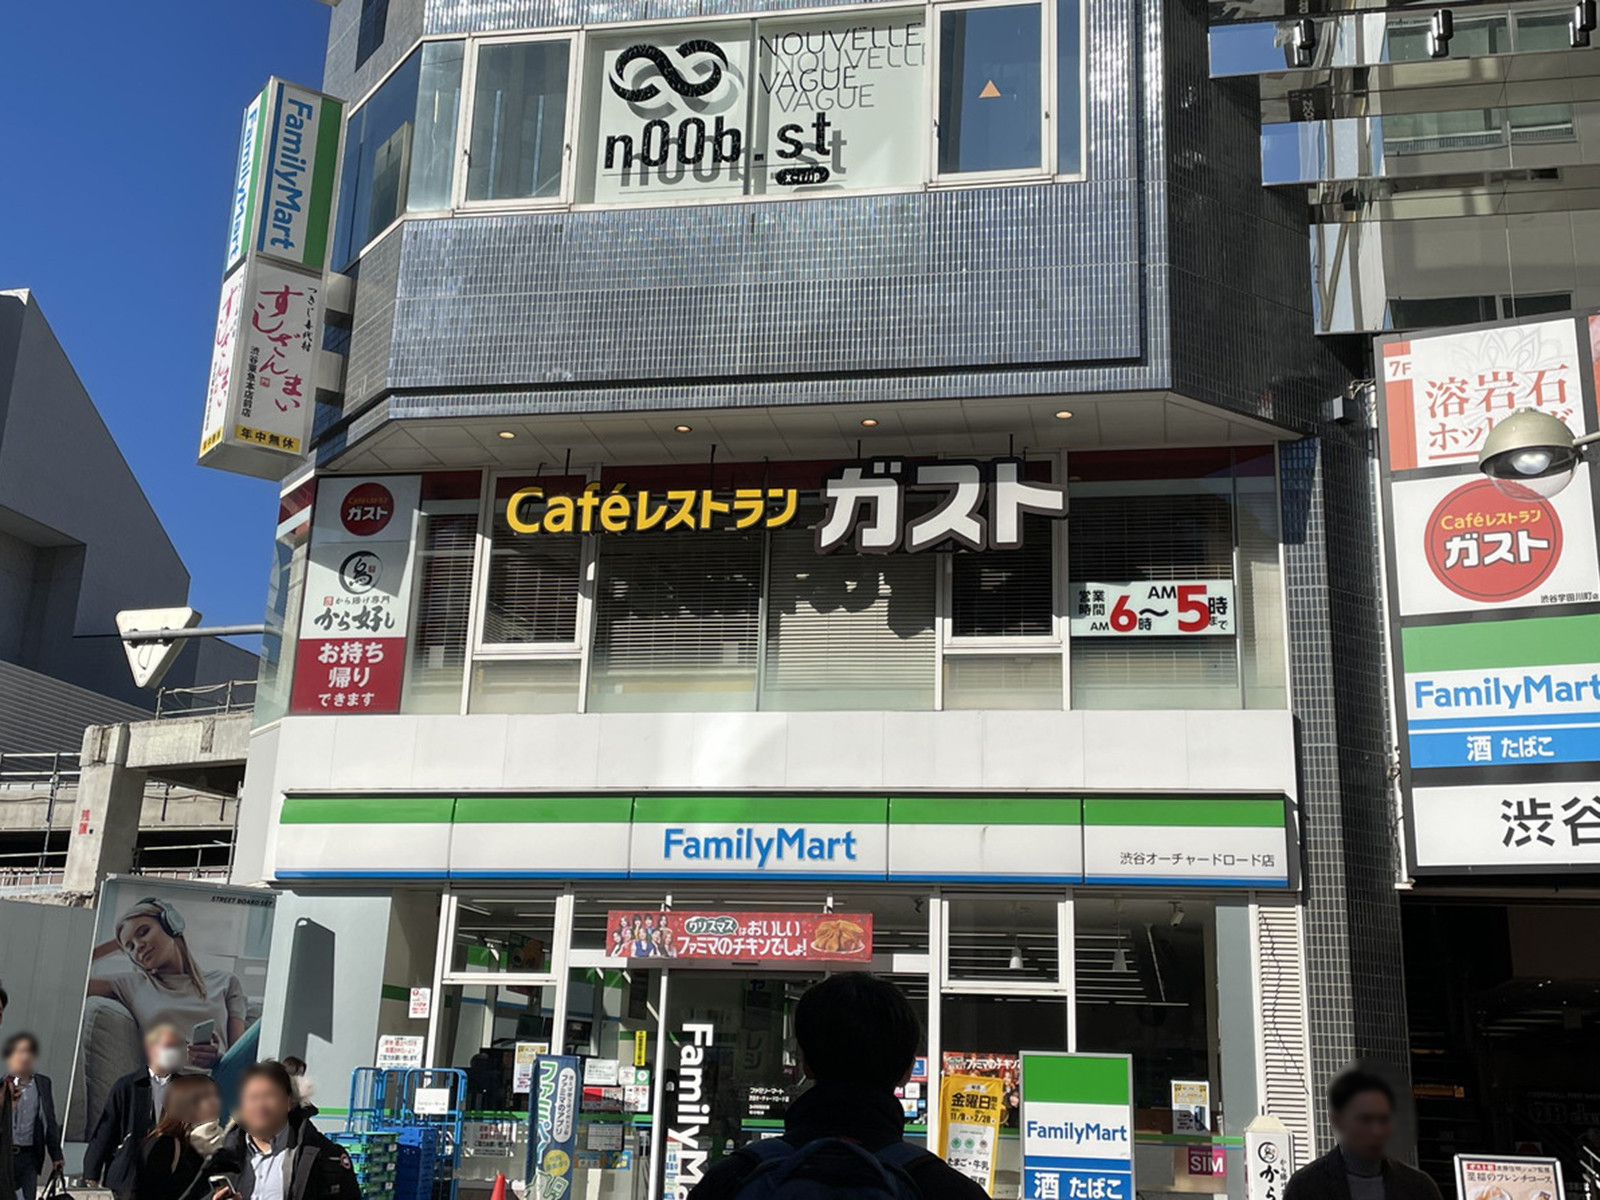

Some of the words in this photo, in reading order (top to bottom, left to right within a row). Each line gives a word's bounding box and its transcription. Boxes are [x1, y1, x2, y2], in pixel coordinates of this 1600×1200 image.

[759, 22, 922, 57] NOUVELLE
[759, 65, 859, 95] VAGUE
[269, 98, 312, 250] FamilyMart
[228, 109, 258, 267] FamilyMart
[252, 284, 304, 413] すしざんまい
[1389, 360, 1412, 377] 7F
[1425, 364, 1570, 419] 溶岩石
[241, 427, 294, 449] 年中無休
[347, 506, 388, 521] ガスト
[505, 482, 798, 534] Caféレストラン
[817, 461, 1066, 549] ガスト
[1441, 508, 1541, 531] Caféレストラン
[1444, 530, 1549, 569] ガスト
[1078, 590, 1105, 602] 営業
[314, 605, 395, 632] から好し
[1078, 603, 1105, 616] 時間
[318, 641, 384, 664] お持ち
[328, 667, 370, 688] 帰り
[318, 692, 375, 707] できます
[1414, 674, 1600, 709] FamilyMart
[1466, 735, 1492, 762] 酒
[1501, 736, 1555, 758] たばこ
[1501, 796, 1600, 847] 渋谷
[664, 827, 858, 869] FamilyMart
[1119, 851, 1276, 869] 渋谷オーチャードロード店
[966, 1058, 1020, 1069] ファミマのチキン
[951, 1092, 991, 1109] 金曜日
[1027, 1120, 1127, 1144] FamilyMart
[1190, 1156, 1223, 1173] SIM
[1034, 1172, 1060, 1200] 酒
[1069, 1176, 1122, 1200] たばこ
[1467, 1172, 1552, 1183] 至福のフレンチコース
